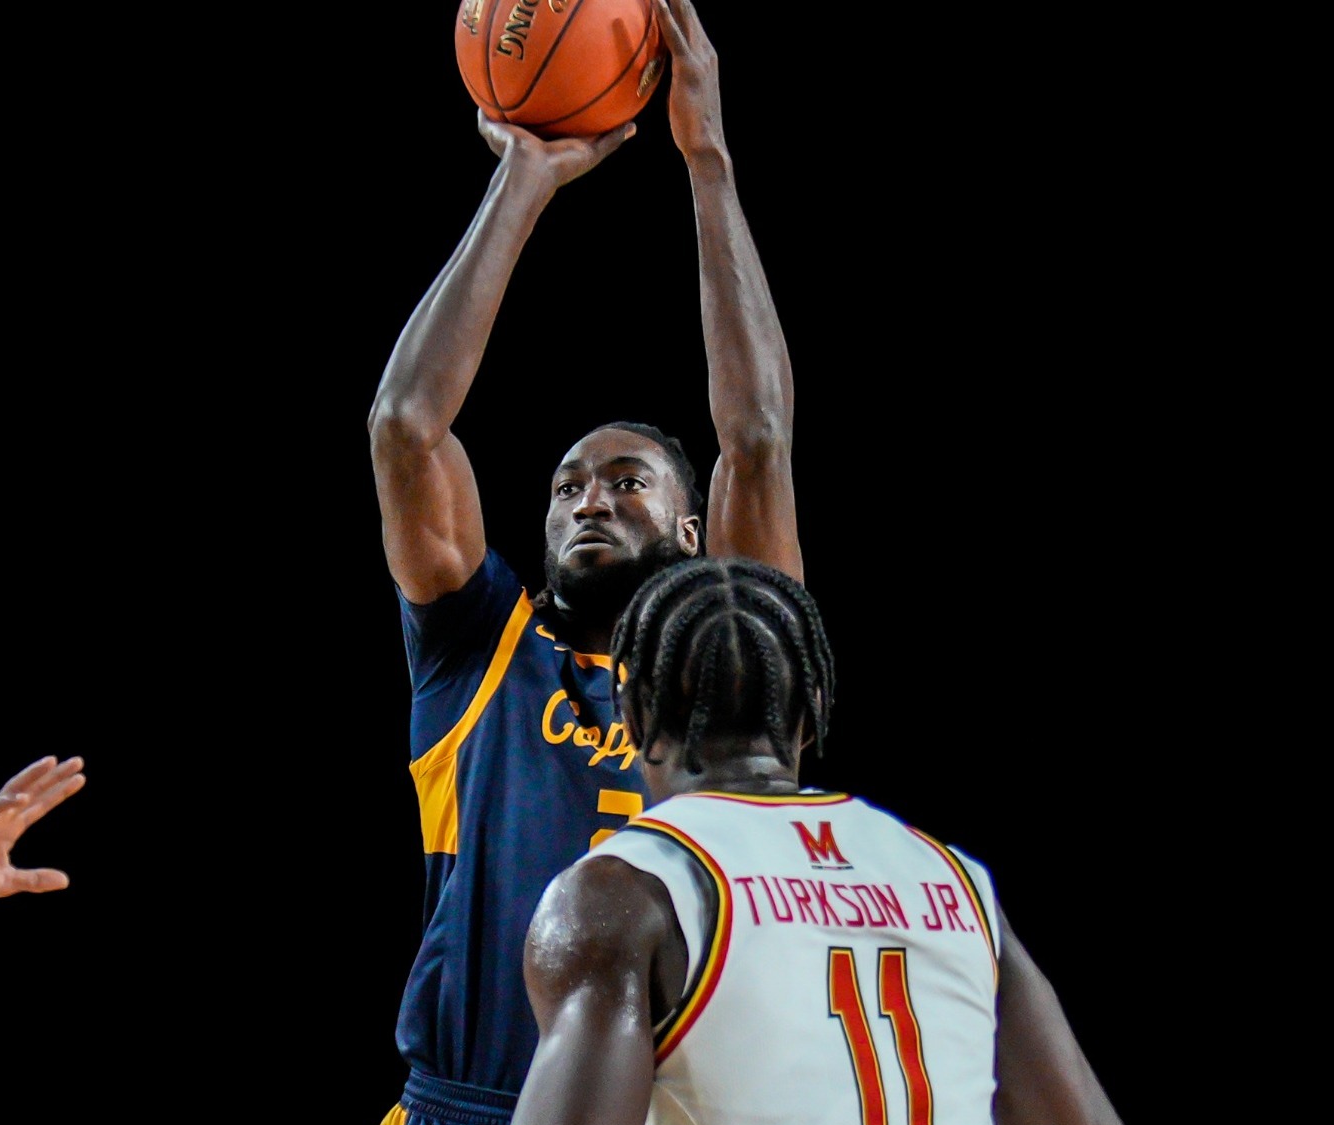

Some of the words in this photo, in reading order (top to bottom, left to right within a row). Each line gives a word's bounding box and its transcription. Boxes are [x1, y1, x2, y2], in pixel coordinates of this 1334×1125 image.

[789, 821, 851, 865] M
[733, 876, 910, 930] TURKSON
[920, 881, 976, 934] JR.
